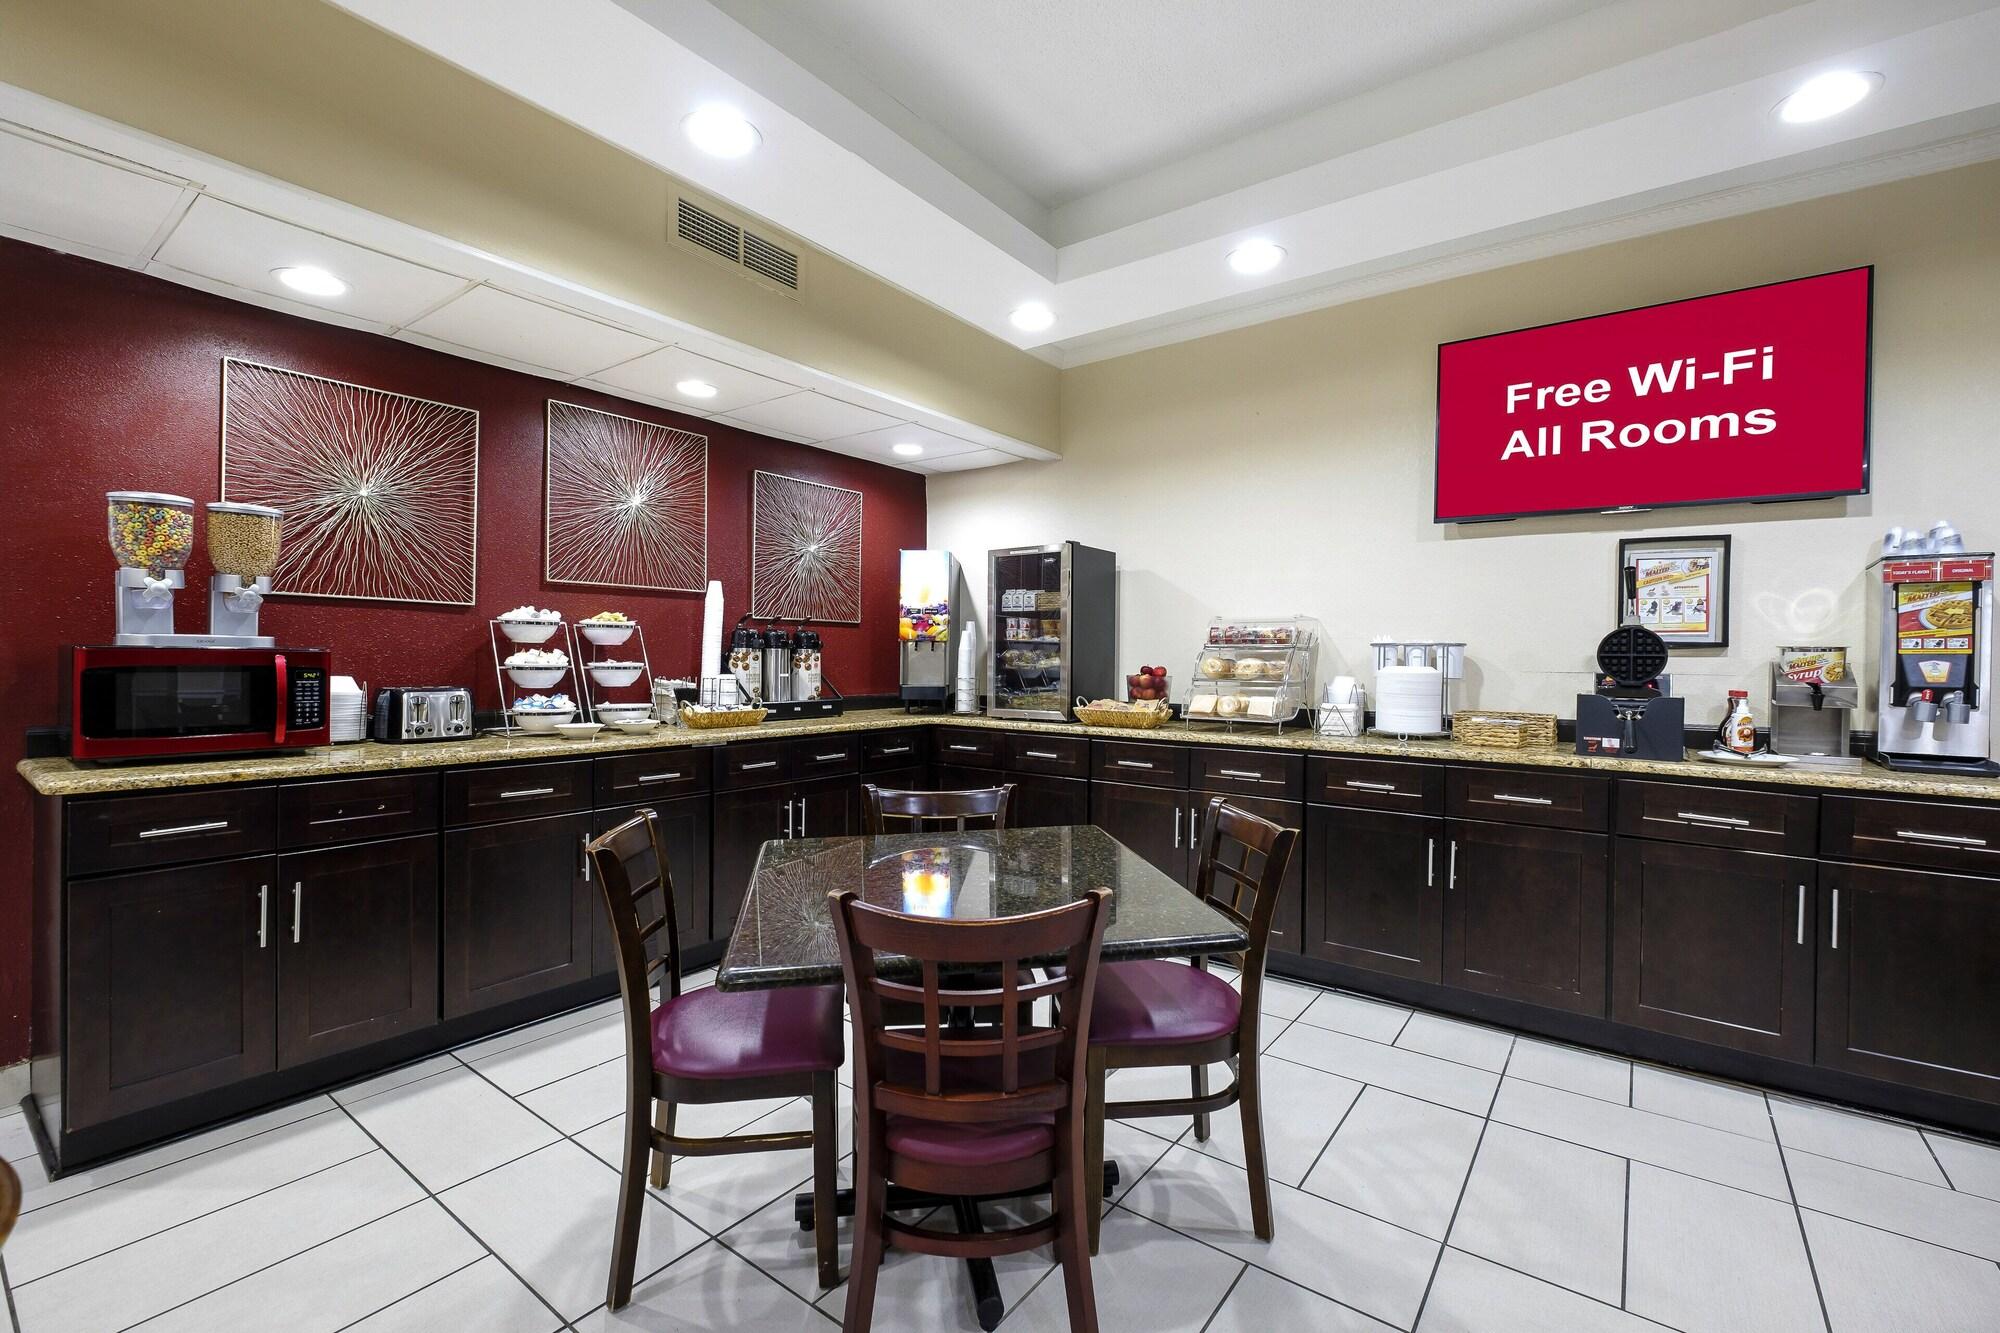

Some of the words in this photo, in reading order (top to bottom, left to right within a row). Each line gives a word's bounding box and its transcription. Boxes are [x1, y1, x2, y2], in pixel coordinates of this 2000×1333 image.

[1506, 378, 1611, 414] Free
[1628, 346, 1774, 397] Wi-Fi
[1501, 426, 1562, 461] All
[1582, 408, 1777, 452] Rooms
[1907, 591, 1940, 602] MALTED
[1789, 661, 1816, 670] MALTED
[1787, 669, 1821, 680] Syrup
